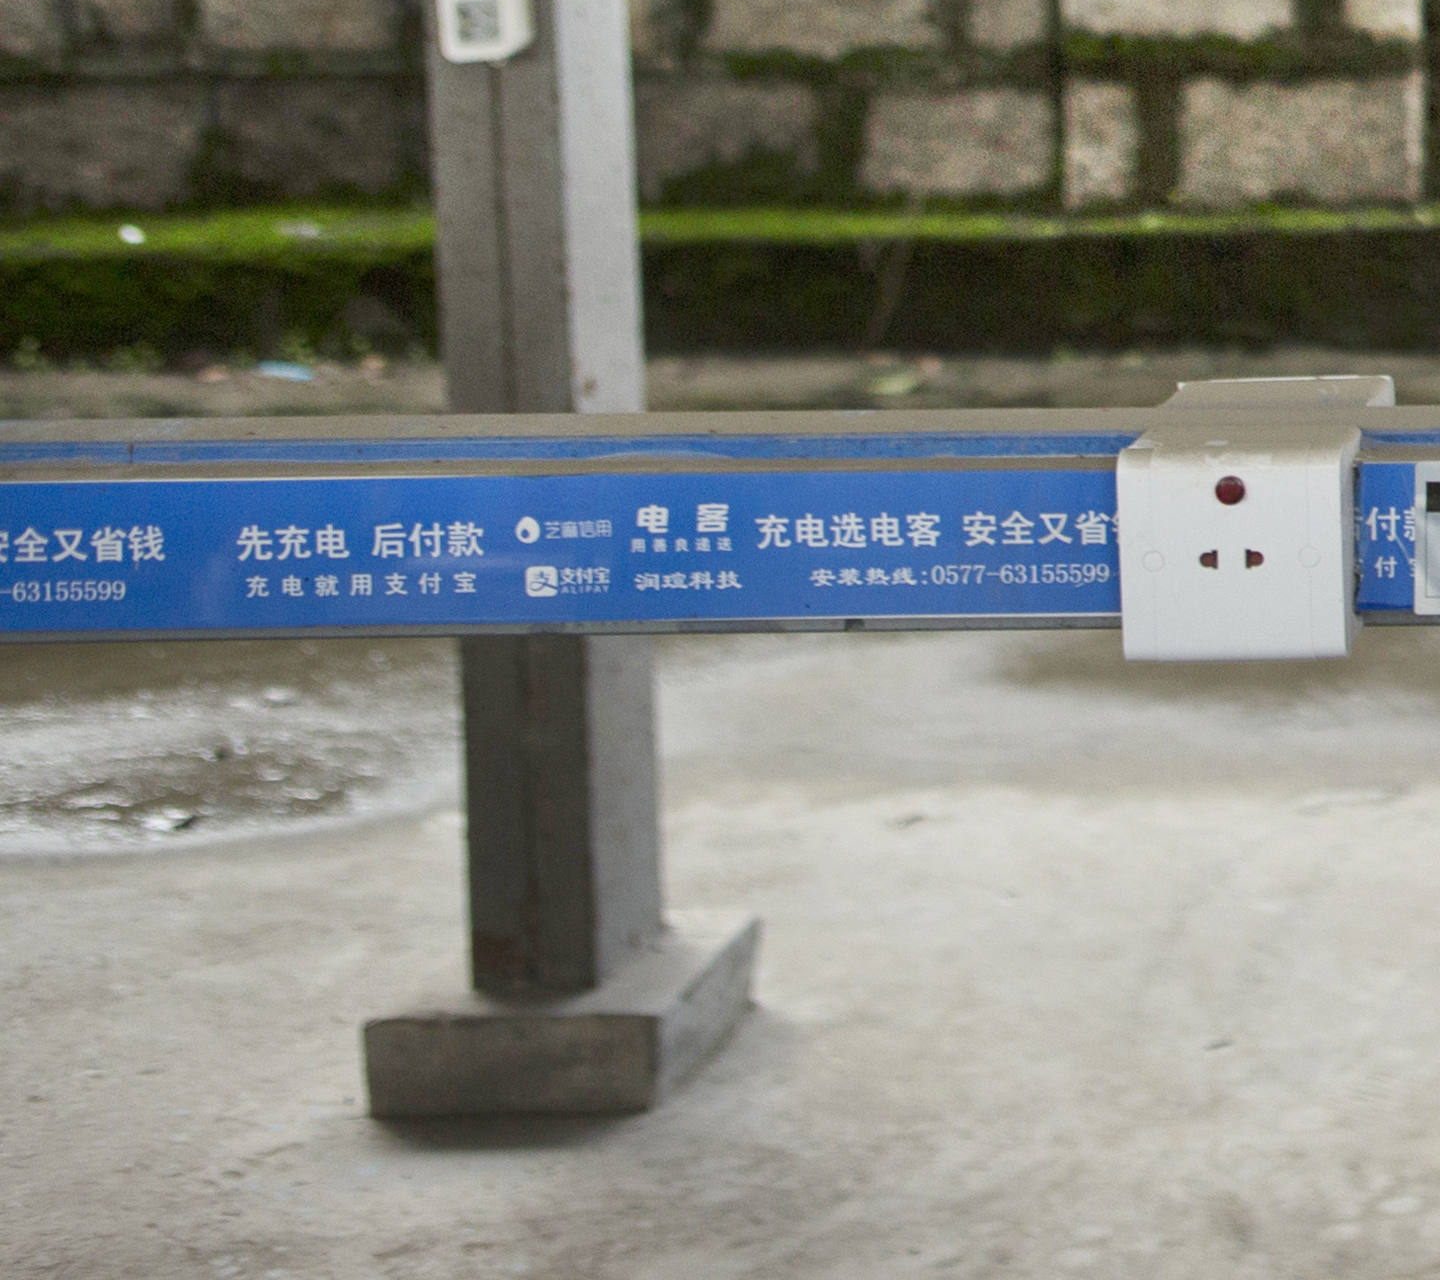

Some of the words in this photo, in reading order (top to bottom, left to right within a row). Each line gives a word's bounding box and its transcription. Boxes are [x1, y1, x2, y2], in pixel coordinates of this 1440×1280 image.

[237, 525, 350, 561] 先充电
[371, 521, 485, 558] 后付款
[545, 519, 612, 540] 芝麻信用
[755, 512, 941, 550] 充电选电客
[962, 510, 1119, 547] 安全又省
[245, 571, 477, 598] 充电就用支付宝
[560, 566, 611, 586] 支付宝
